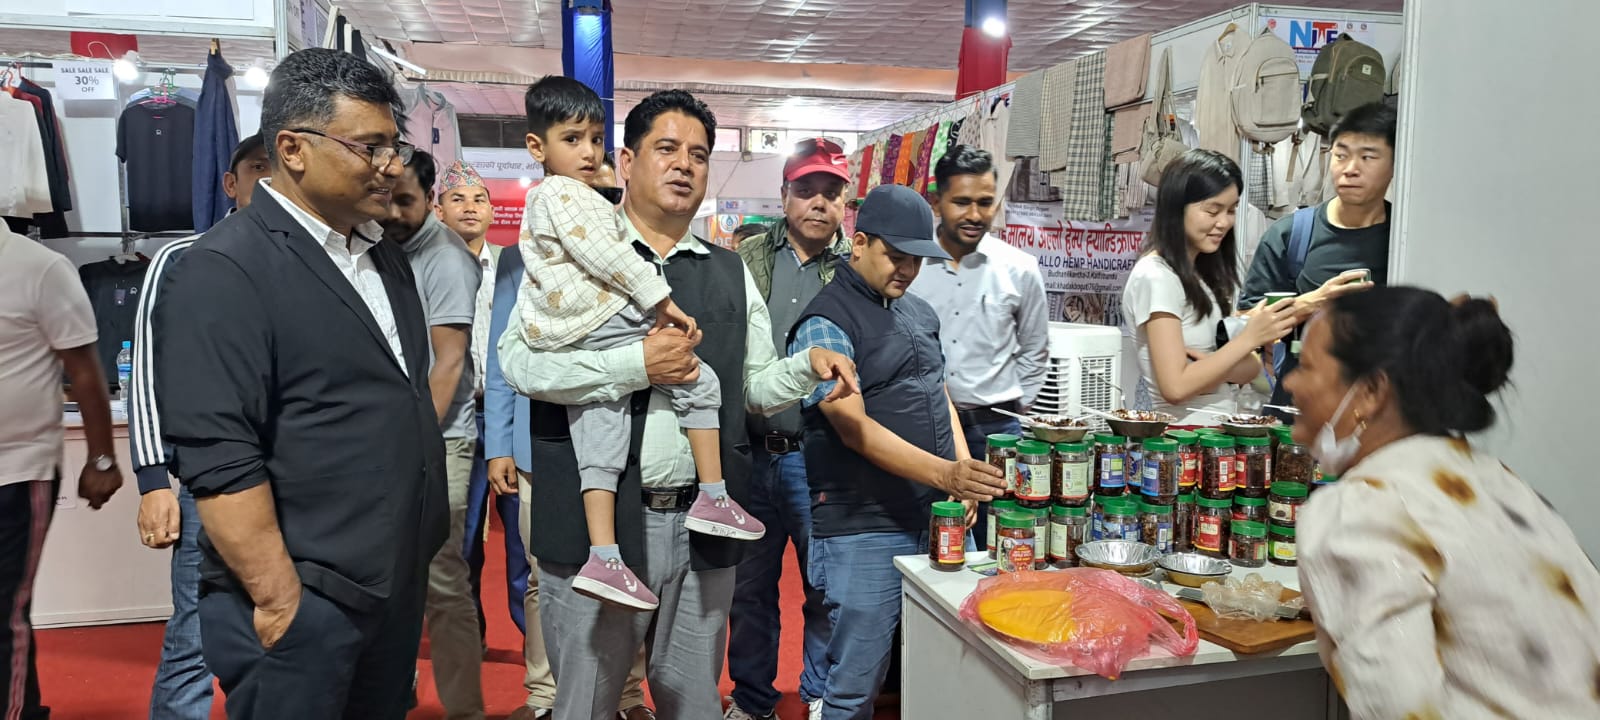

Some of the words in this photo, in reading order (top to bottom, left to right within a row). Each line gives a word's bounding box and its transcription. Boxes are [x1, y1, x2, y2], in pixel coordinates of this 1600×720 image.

[74, 75, 100, 86] 30%
[1038, 220, 1063, 251] अल्लो
[1038, 256, 1061, 268] ALLO
[1062, 256, 1086, 269] HEMP
